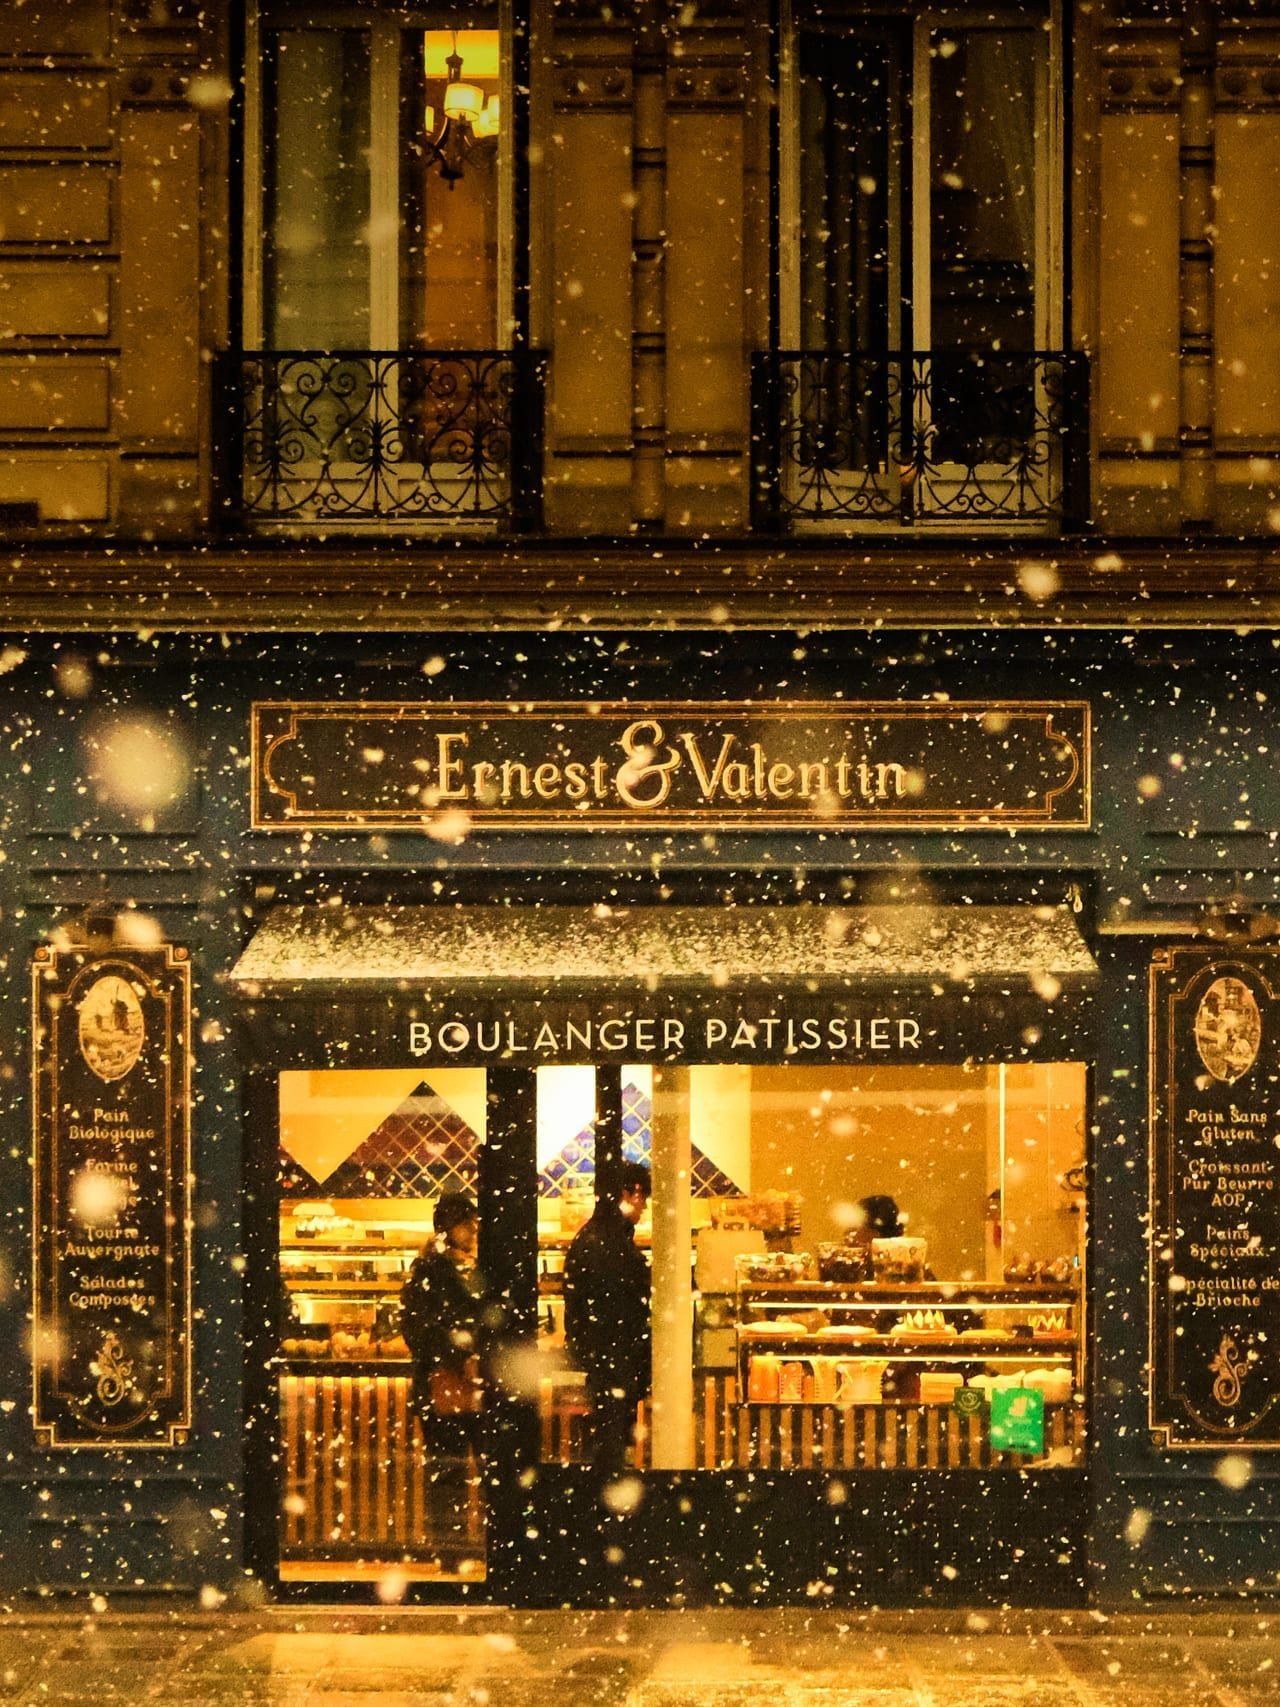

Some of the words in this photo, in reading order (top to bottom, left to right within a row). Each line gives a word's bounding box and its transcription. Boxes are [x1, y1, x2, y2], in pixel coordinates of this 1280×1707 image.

[434, 732, 608, 800] Ernest
[615, 719, 682, 809] &
[679, 732, 908, 800] Valentin
[408, 1019, 684, 1053] BOULANGER
[706, 1018, 921, 1051] PATISSIER
[94, 1108, 129, 1122] Pain
[1188, 1109, 1224, 1123] Pain
[1230, 1108, 1267, 1123] Sans
[69, 1125, 155, 1144] Biologique
[1201, 1126, 1256, 1144] Gluten
[85, 1159, 138, 1173] Farine
[1188, 1159, 1268, 1175] Croissant
[1183, 1177, 1210, 1190] Pur
[1217, 1177, 1273, 1190] Beurre
[1211, 1193, 1245, 1207] AOP
[1207, 1224, 1250, 1240] Pains
[65, 1242, 160, 1261] Auvergnate
[80, 1275, 145, 1289] Salads
[1174, 1276, 1257, 1295] pécialité
[1261, 1277, 1280, 1290] de
[1196, 1293, 1261, 1307] Brioche
